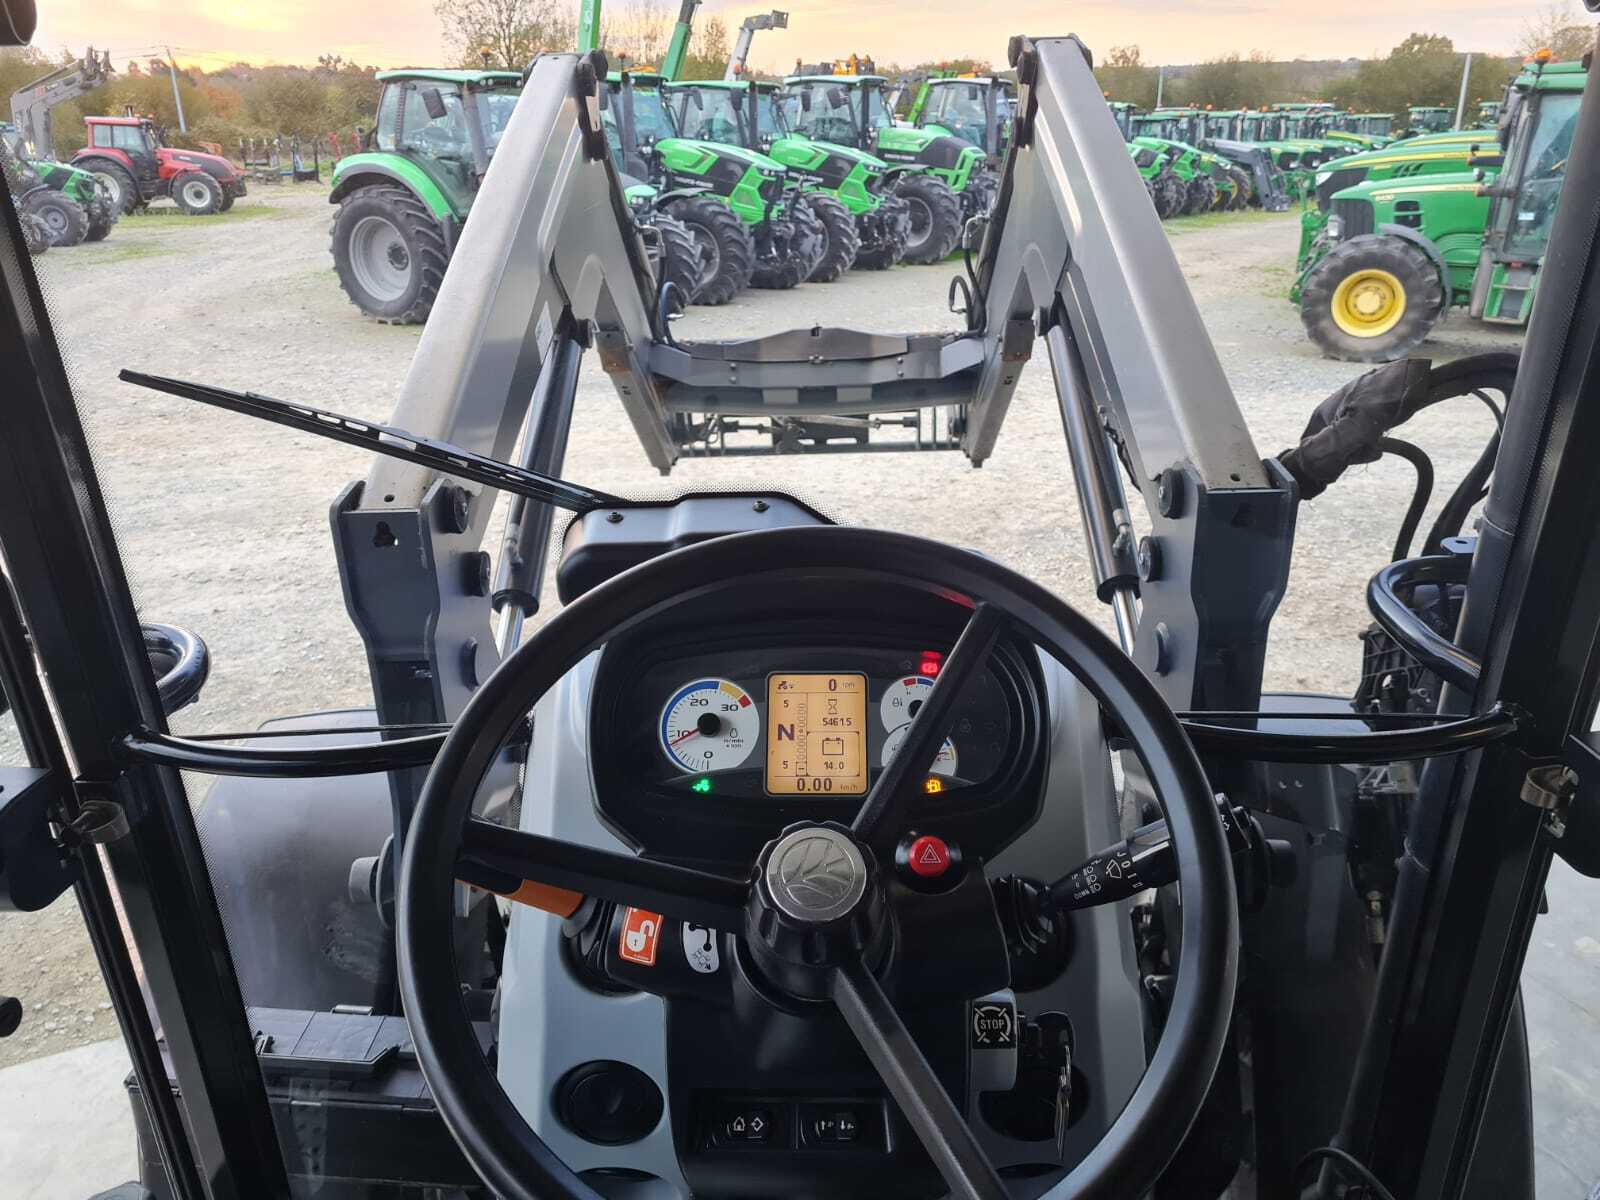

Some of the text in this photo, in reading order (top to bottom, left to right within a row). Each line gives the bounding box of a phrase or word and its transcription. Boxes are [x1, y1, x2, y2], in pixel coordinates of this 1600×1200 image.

[828, 678, 838, 691] 0
[690, 698, 709, 707] 20
[783, 700, 790, 708] 5
[720, 704, 739, 712] 30
[676, 730, 690, 738] 10
[777, 723, 795, 741] N
[703, 750, 714, 759] 0
[782, 760, 789, 769] 5
[796, 778, 833, 792] 0.00
[980, 1018, 1005, 1030] STOP
